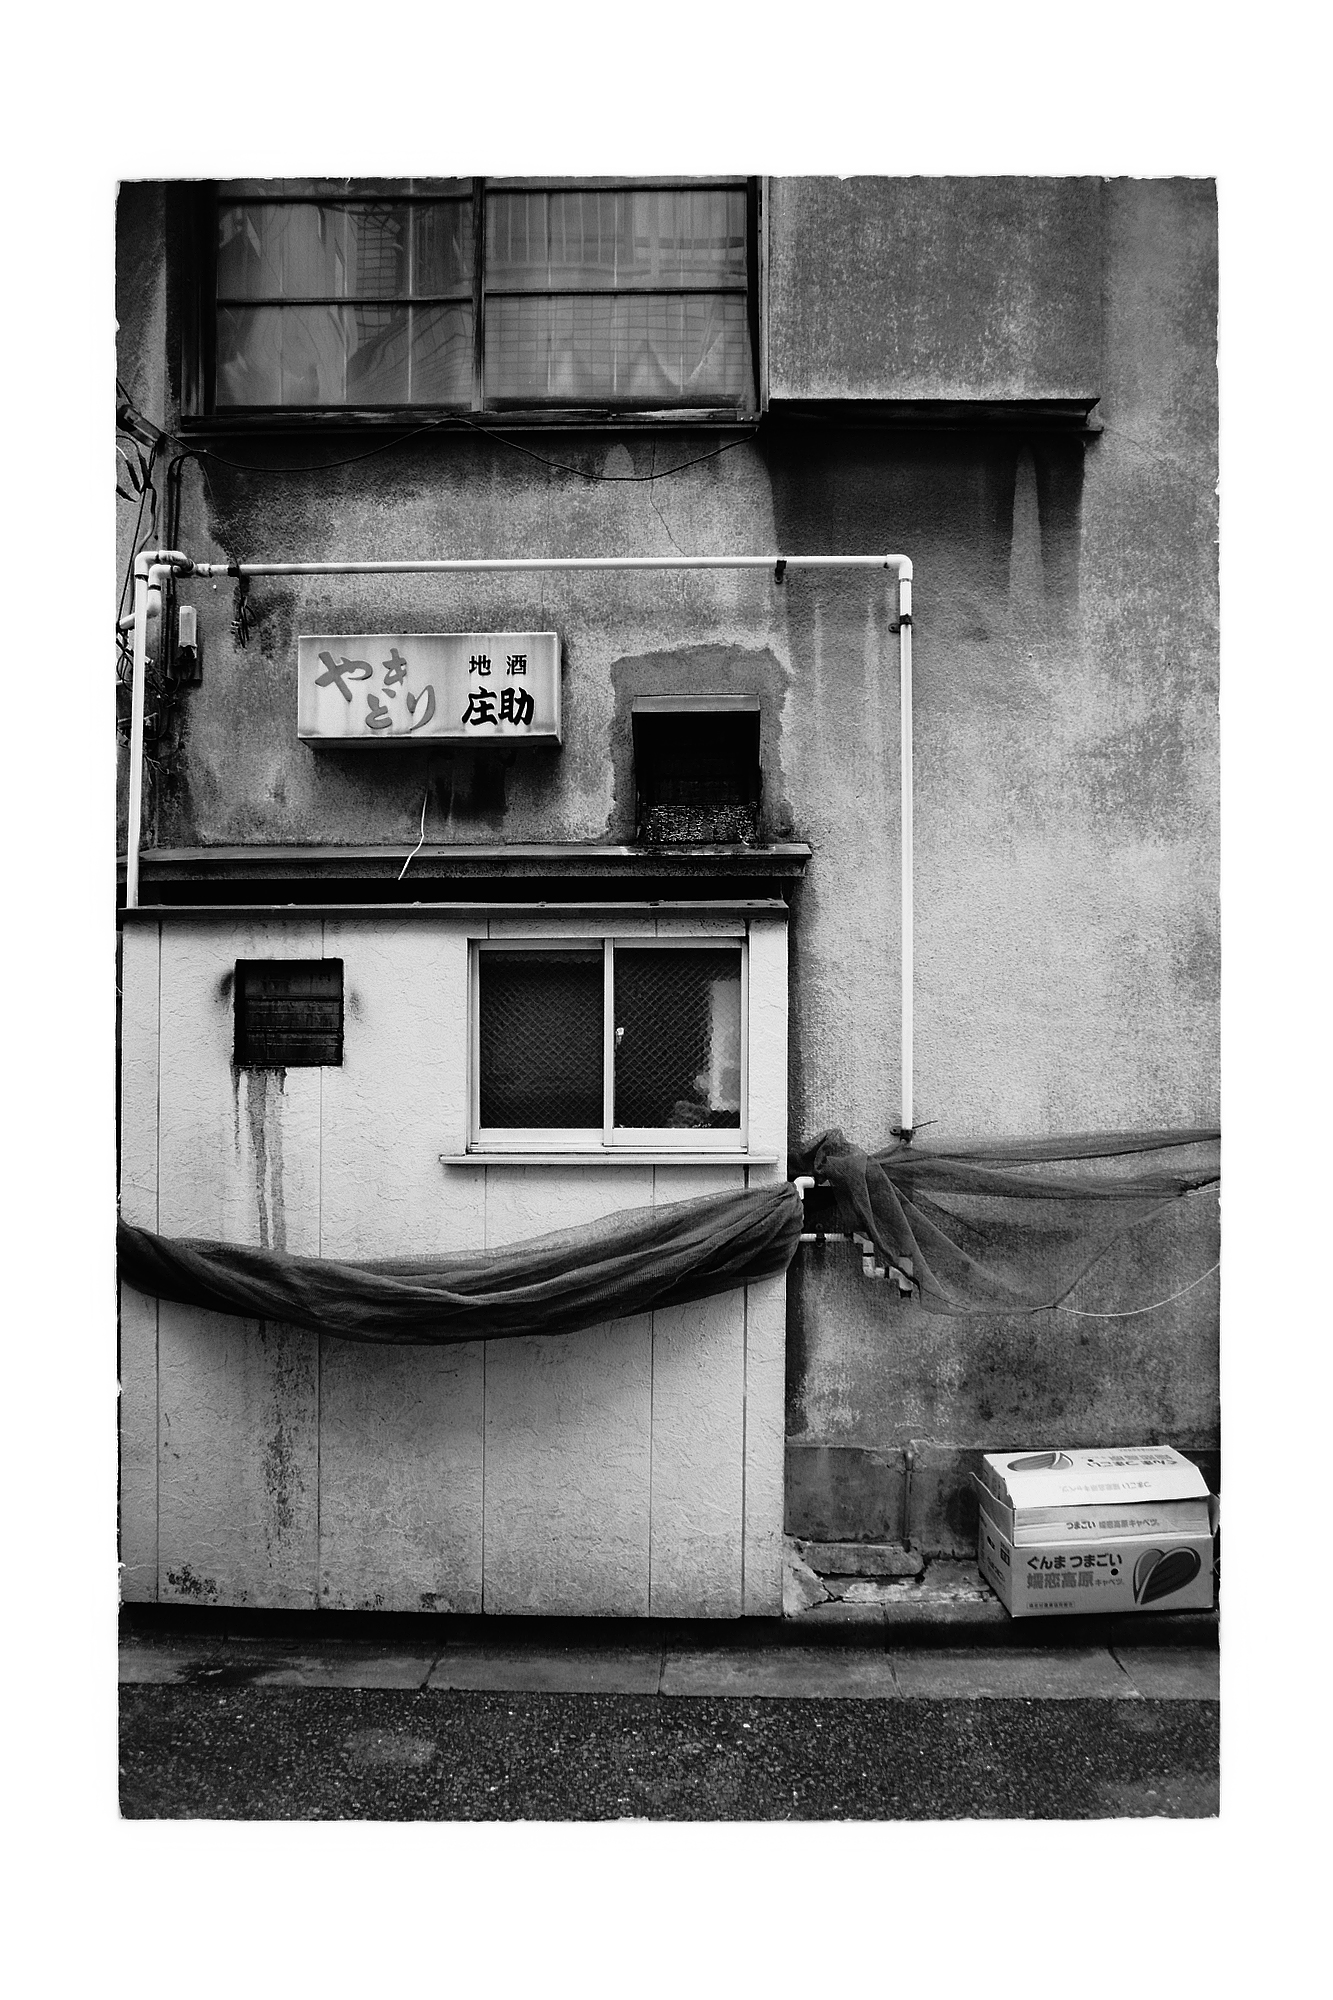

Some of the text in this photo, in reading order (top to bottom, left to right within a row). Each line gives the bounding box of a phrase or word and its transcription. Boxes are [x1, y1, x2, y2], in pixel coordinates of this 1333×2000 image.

[468, 653, 527, 676] 地酒
[461, 685, 535, 726] 庄助
[1066, 1520, 1096, 1530] つまごい
[1026, 1552, 1123, 1570] ぐんま つまごい
